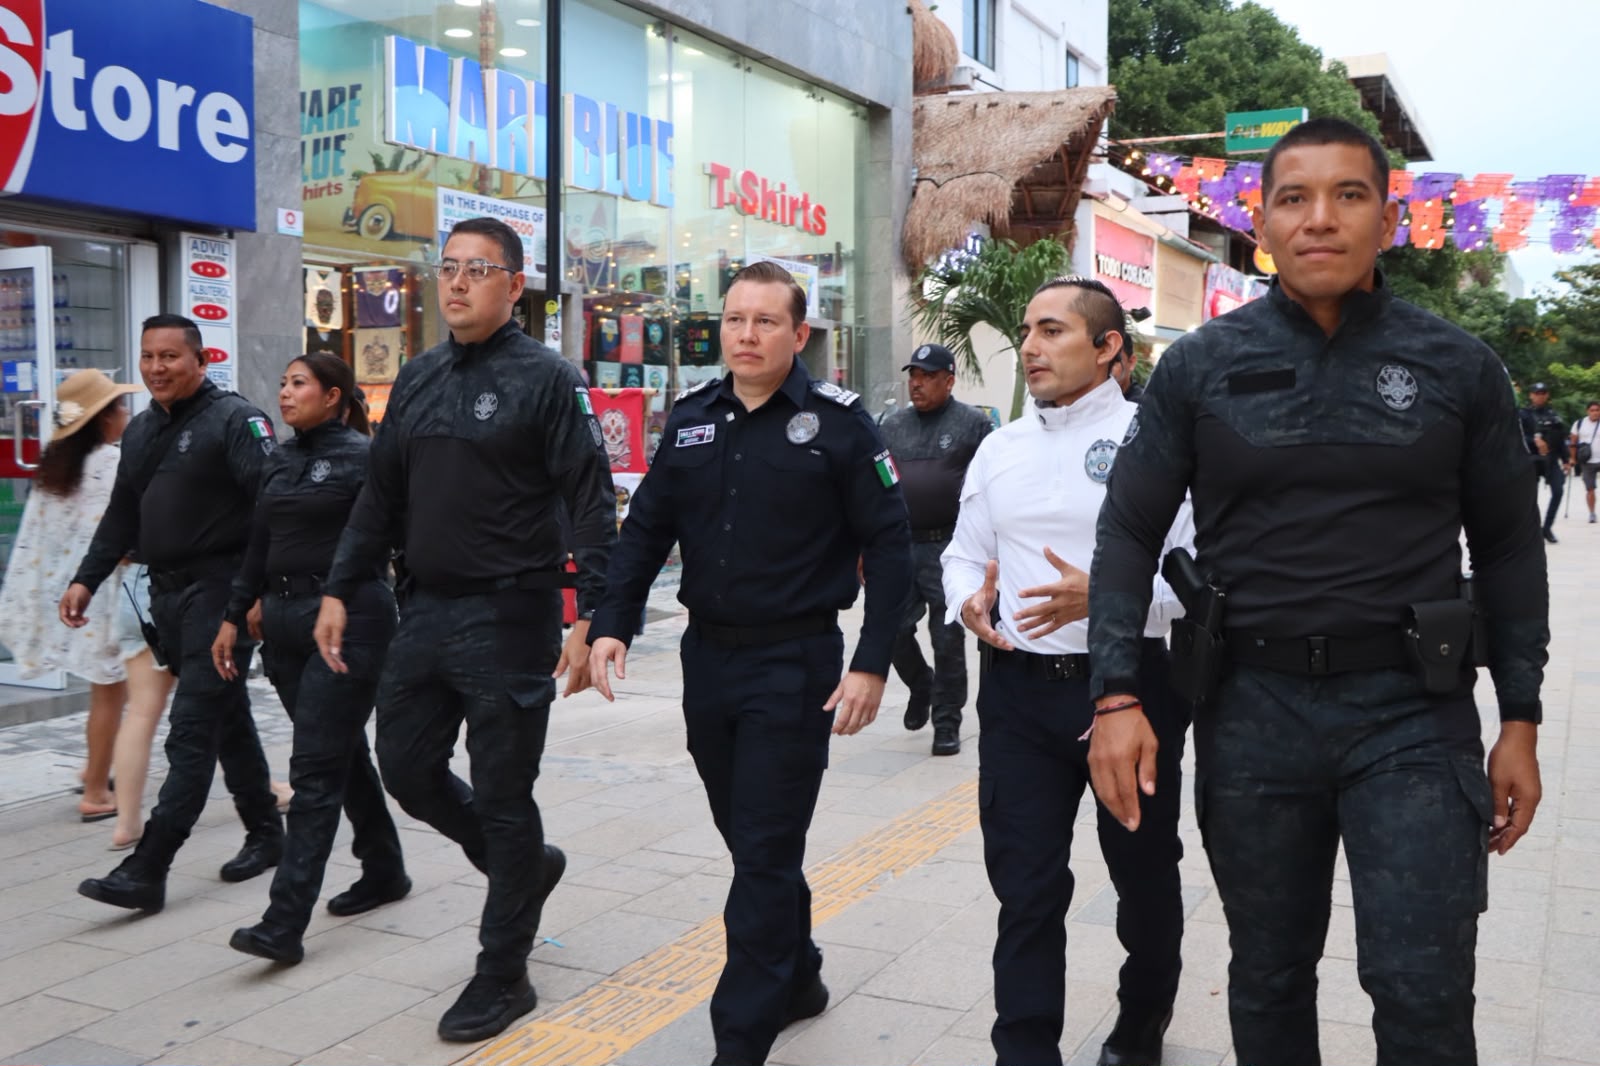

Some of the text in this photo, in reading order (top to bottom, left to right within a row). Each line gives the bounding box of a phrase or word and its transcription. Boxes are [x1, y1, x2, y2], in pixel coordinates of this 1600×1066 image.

[300, 84, 362, 134] ARE
[301, 133, 347, 183] LUE
[565, 92, 675, 208] BLUE
[302, 181, 344, 201] hirts
[443, 194, 455, 206] IN
[457, 197, 476, 211] THE
[479, 201, 529, 220] PURCHASE
[531, 212, 544, 223] OF
[191, 239, 229, 256] ADVIL
[1096, 253, 1121, 280] TODO
